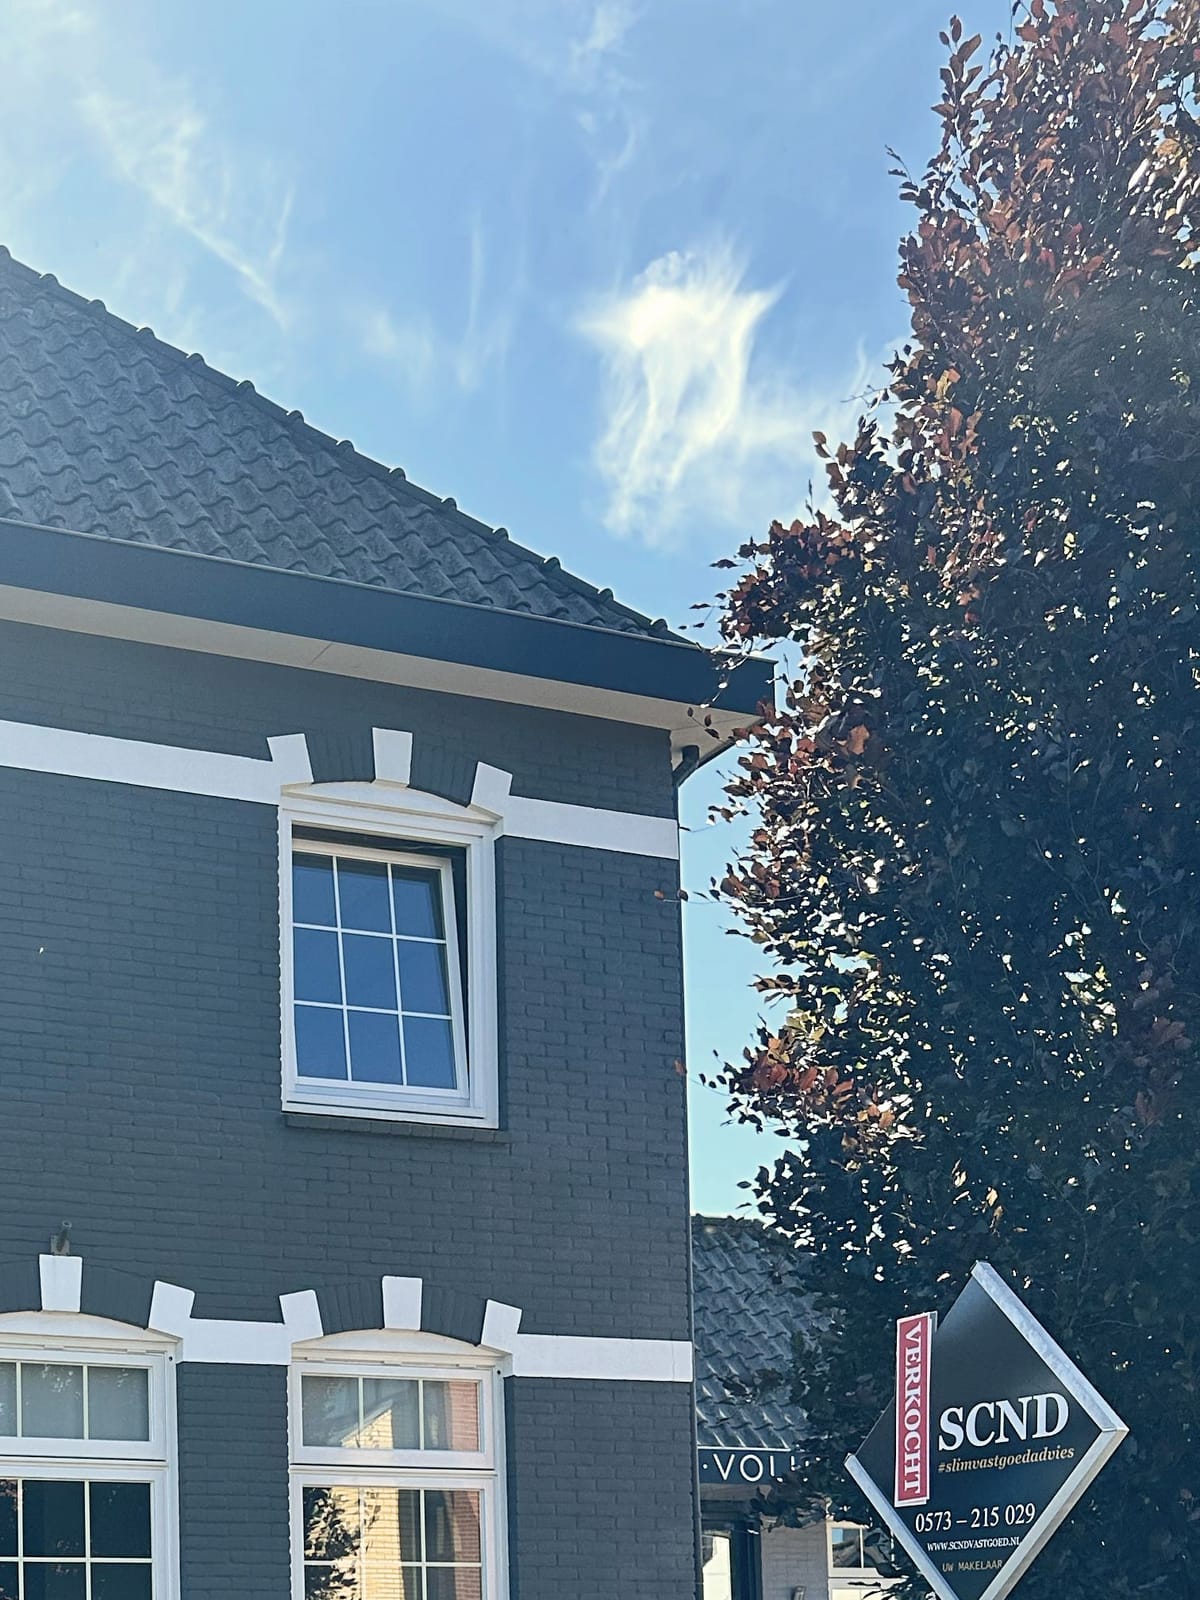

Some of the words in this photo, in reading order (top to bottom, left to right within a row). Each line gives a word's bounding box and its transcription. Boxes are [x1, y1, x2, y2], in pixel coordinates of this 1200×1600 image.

[902, 1321, 923, 1496] VERKOCHT
[938, 1391, 1070, 1451] SCND
[937, 1445, 1075, 1474] #slimvastgoedadvies
[915, 1510, 952, 1533] 0573
[970, 1506, 1000, 1528] 215
[1004, 1502, 1036, 1525] 029
[926, 1536, 1021, 1552] WWW.SCNDVASTGOED.NL
[942, 1563, 954, 1572] UW
[958, 1559, 1003, 1571] MAKELAAR
